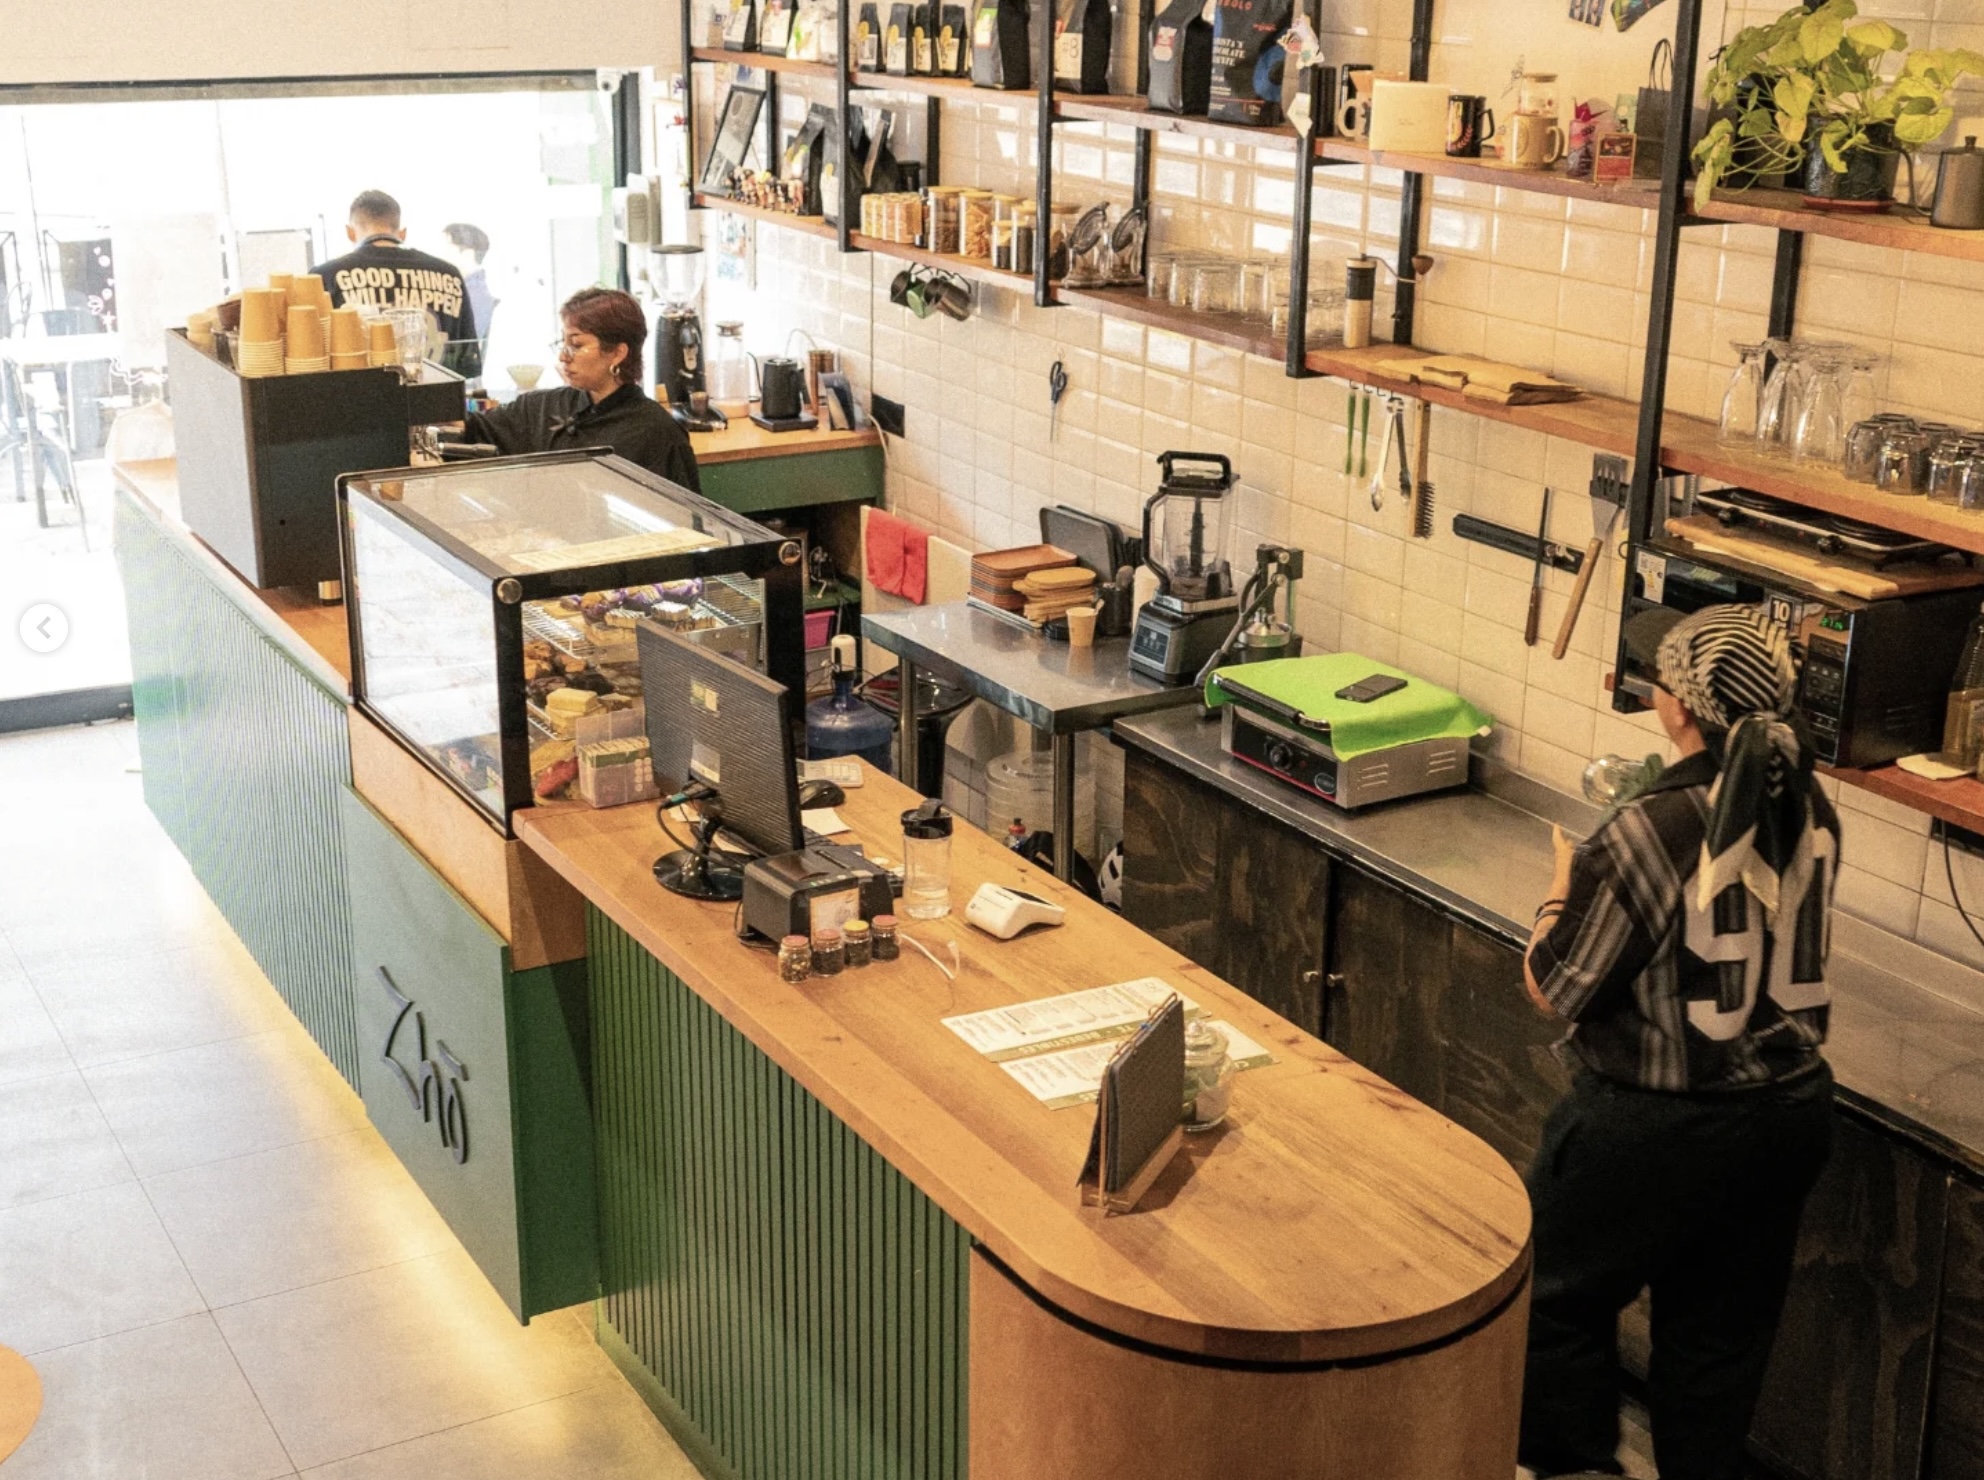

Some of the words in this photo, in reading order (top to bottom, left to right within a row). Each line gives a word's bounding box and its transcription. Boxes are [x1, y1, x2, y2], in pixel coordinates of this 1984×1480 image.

[335, 267, 396, 291] GOOD
[396, 268, 463, 296] THINGS
[342, 287, 392, 309] WILL
[393, 287, 463, 318] HAPPEN
[1772, 599, 1790, 622] 10
